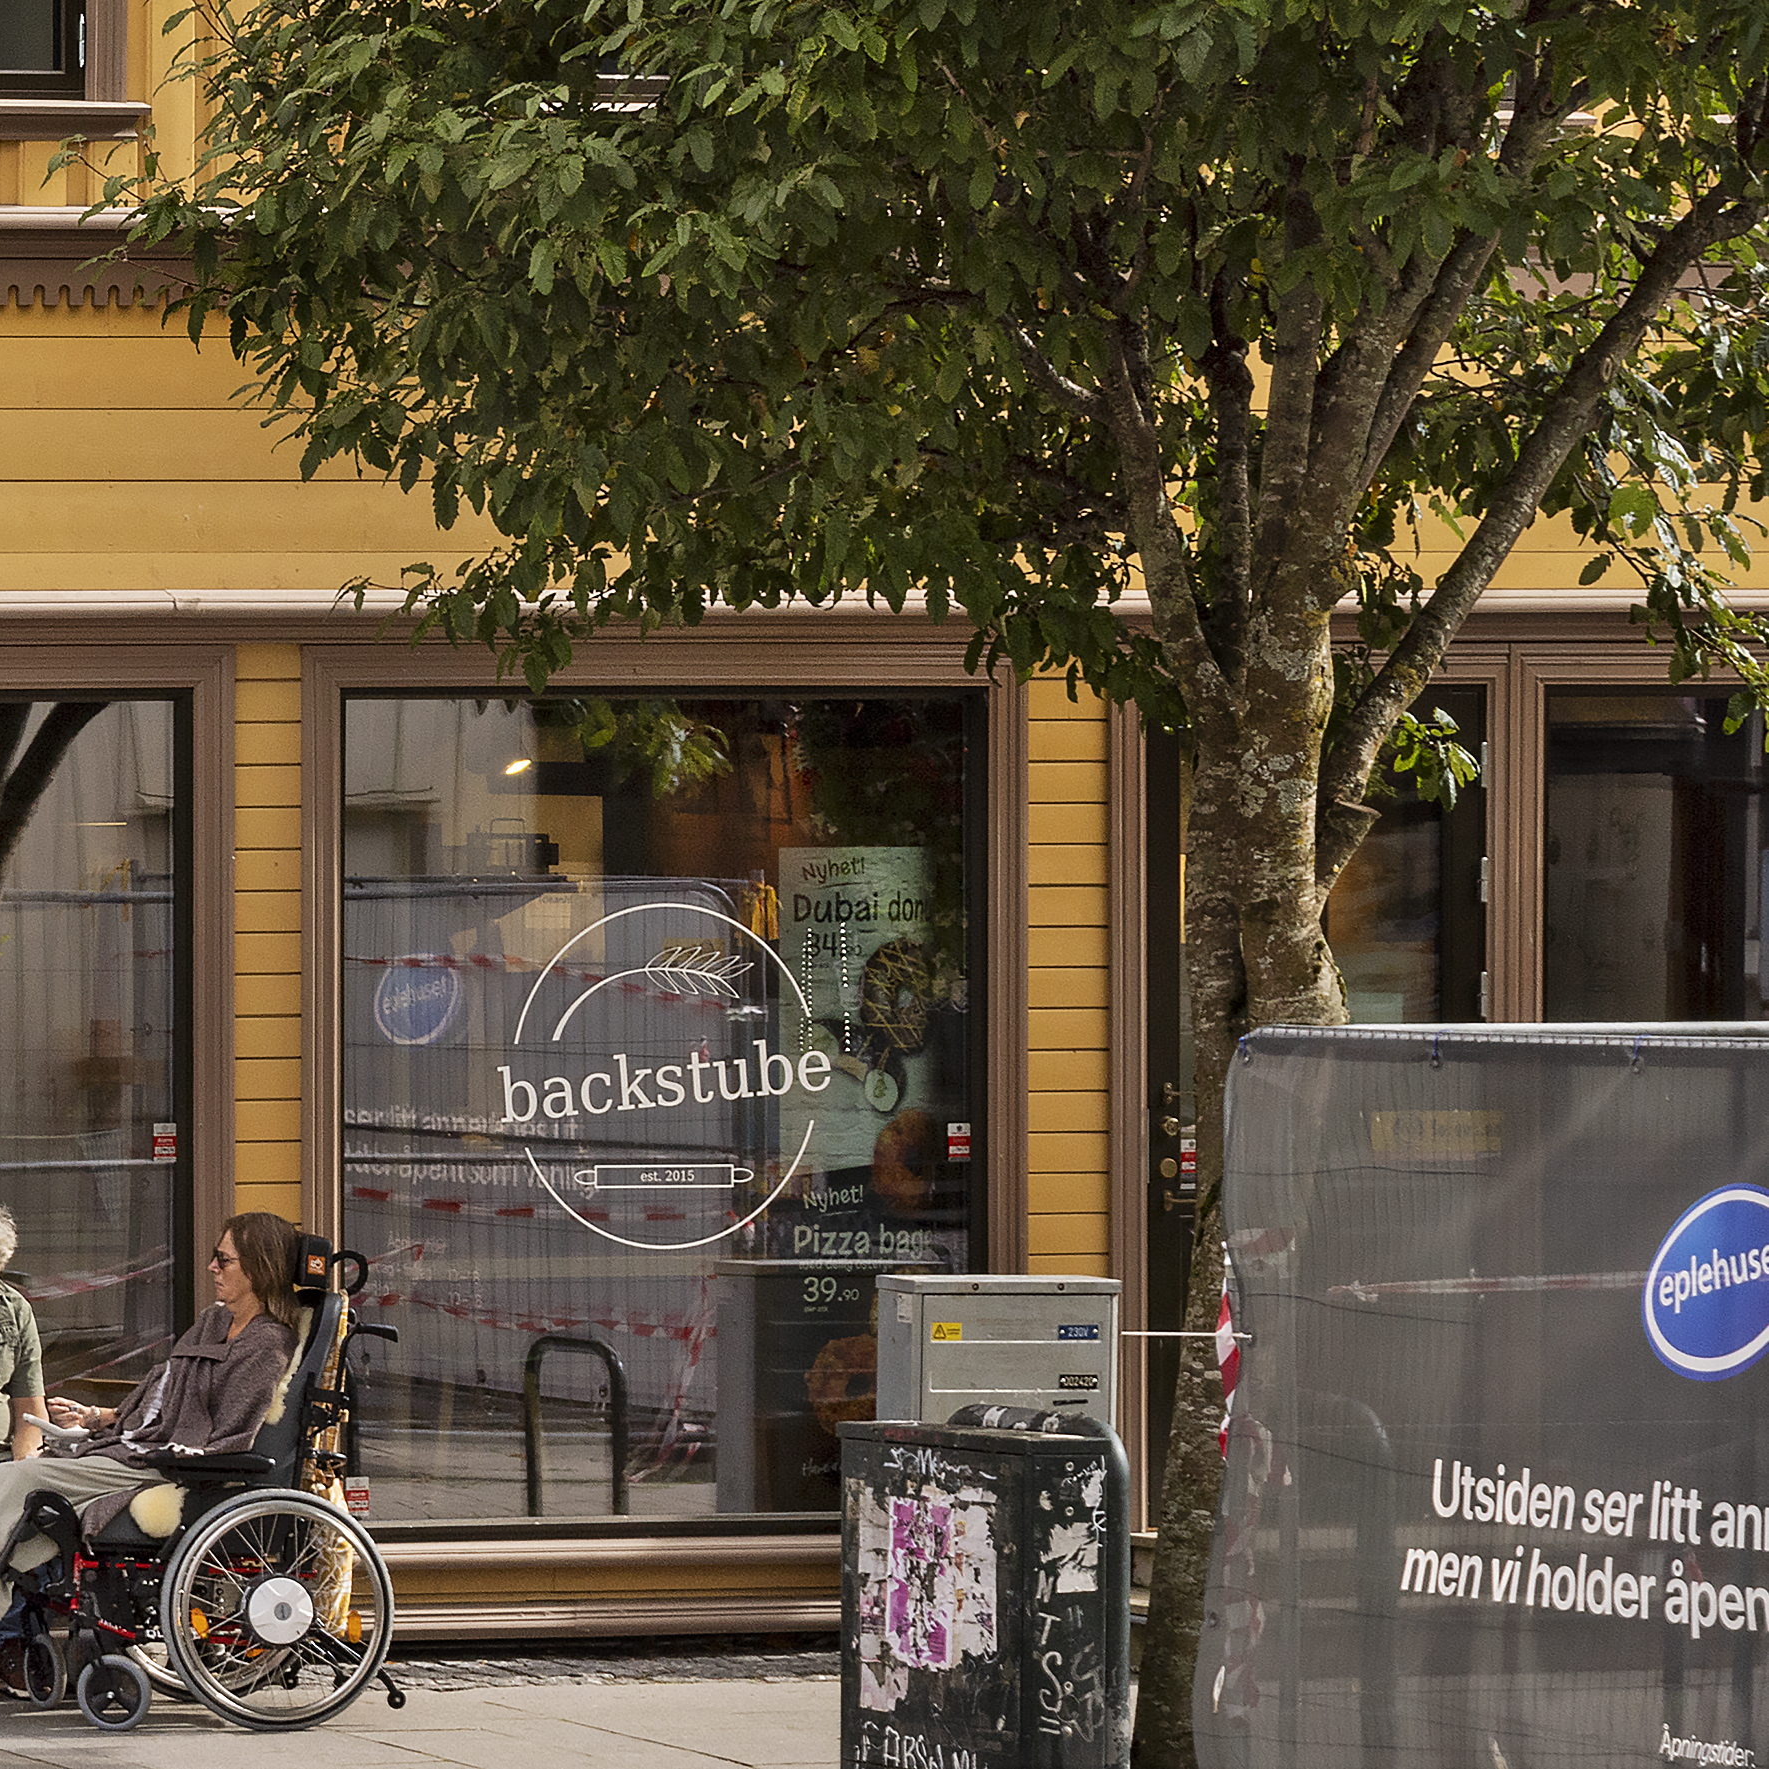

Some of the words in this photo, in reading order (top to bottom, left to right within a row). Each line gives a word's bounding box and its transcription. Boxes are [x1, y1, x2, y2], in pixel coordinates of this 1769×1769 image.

[801, 856, 865, 883] Nyhet!
[793, 891, 879, 923] Dubai
[497, 1039, 832, 1124] backstube
[640, 1171, 662, 1182] est.
[665, 1169, 695, 1182] 2015
[803, 1185, 863, 1213] Nyhet!
[794, 1224, 870, 1255] Pizza
[1067, 1327, 1089, 1337] 230V
[1432, 1458, 1575, 1530] Utsiden
[1581, 1487, 1644, 1537] ser
[1648, 1480, 1703, 1545] litt
[1400, 1547, 1483, 1599] men
[1491, 1545, 1524, 1604] vi
[1525, 1548, 1656, 1620] holder
[1659, 1722, 1756, 1768] Åpningstider:
